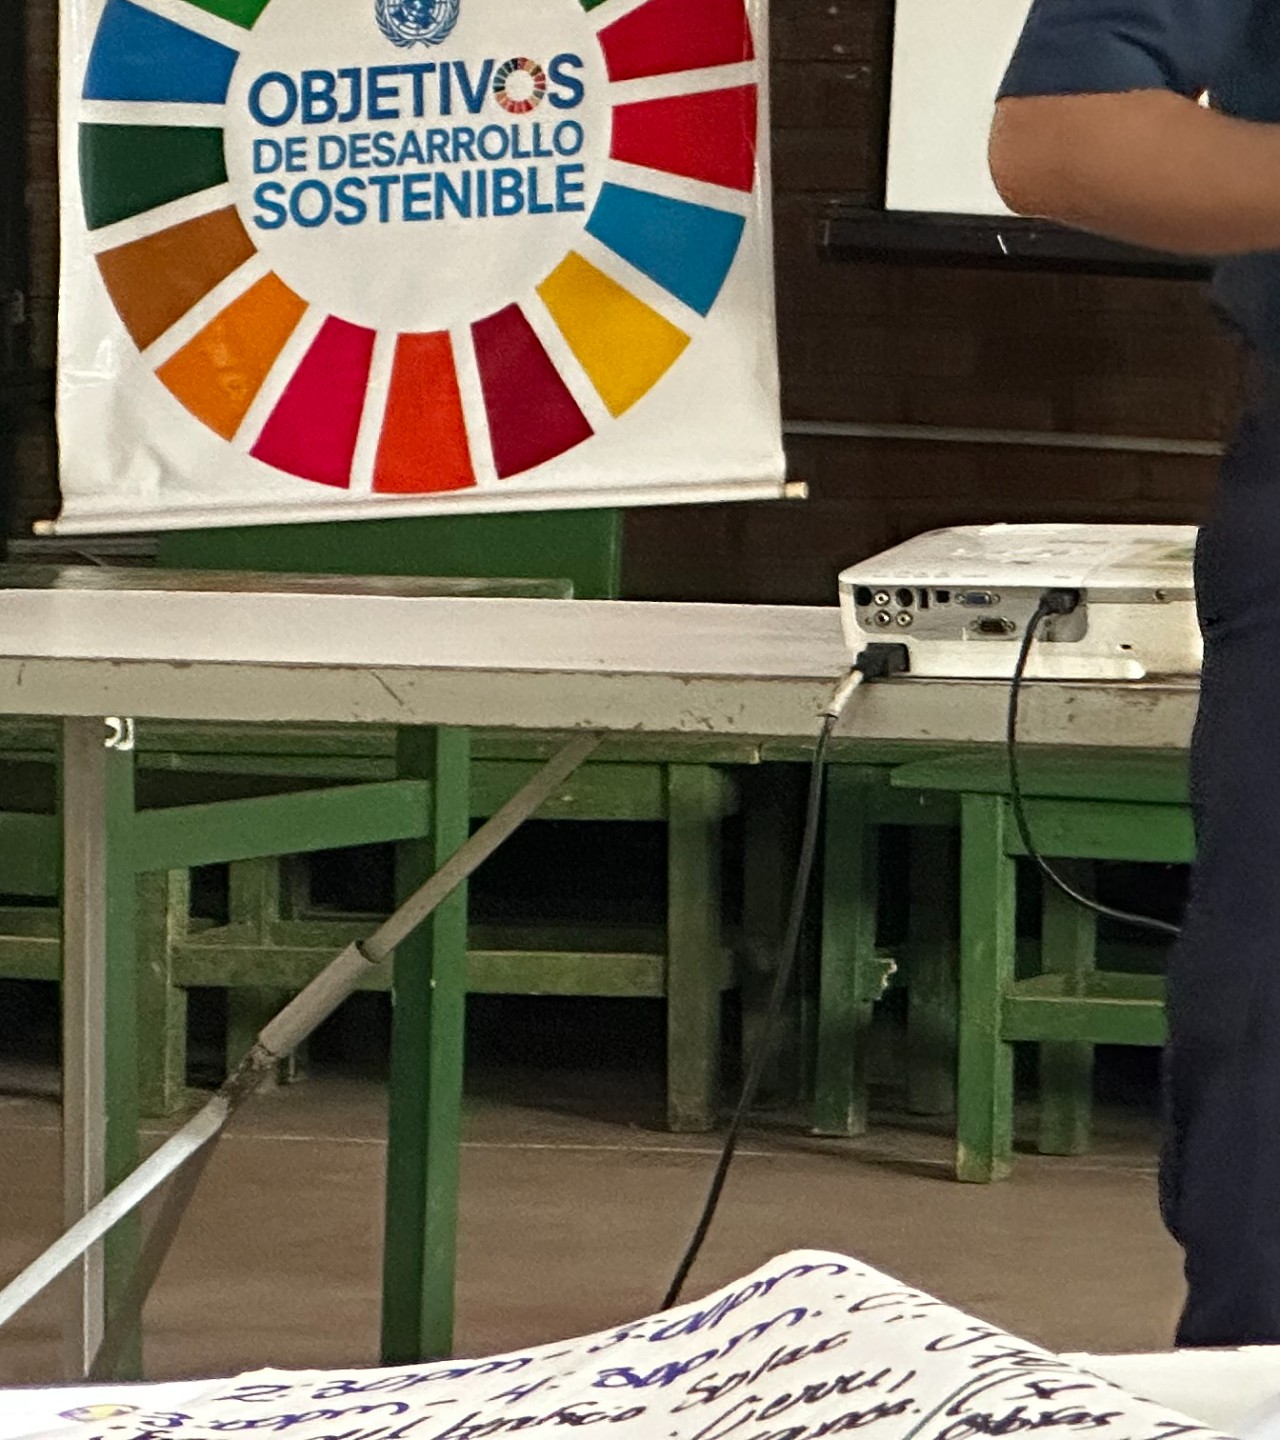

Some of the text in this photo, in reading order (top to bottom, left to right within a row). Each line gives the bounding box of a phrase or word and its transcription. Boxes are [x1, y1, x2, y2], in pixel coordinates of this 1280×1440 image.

[248, 52, 584, 127] OBJETIVOS
[253, 120, 584, 174] DE DESARROLLO
[253, 163, 584, 229] SOSTENIBLE
